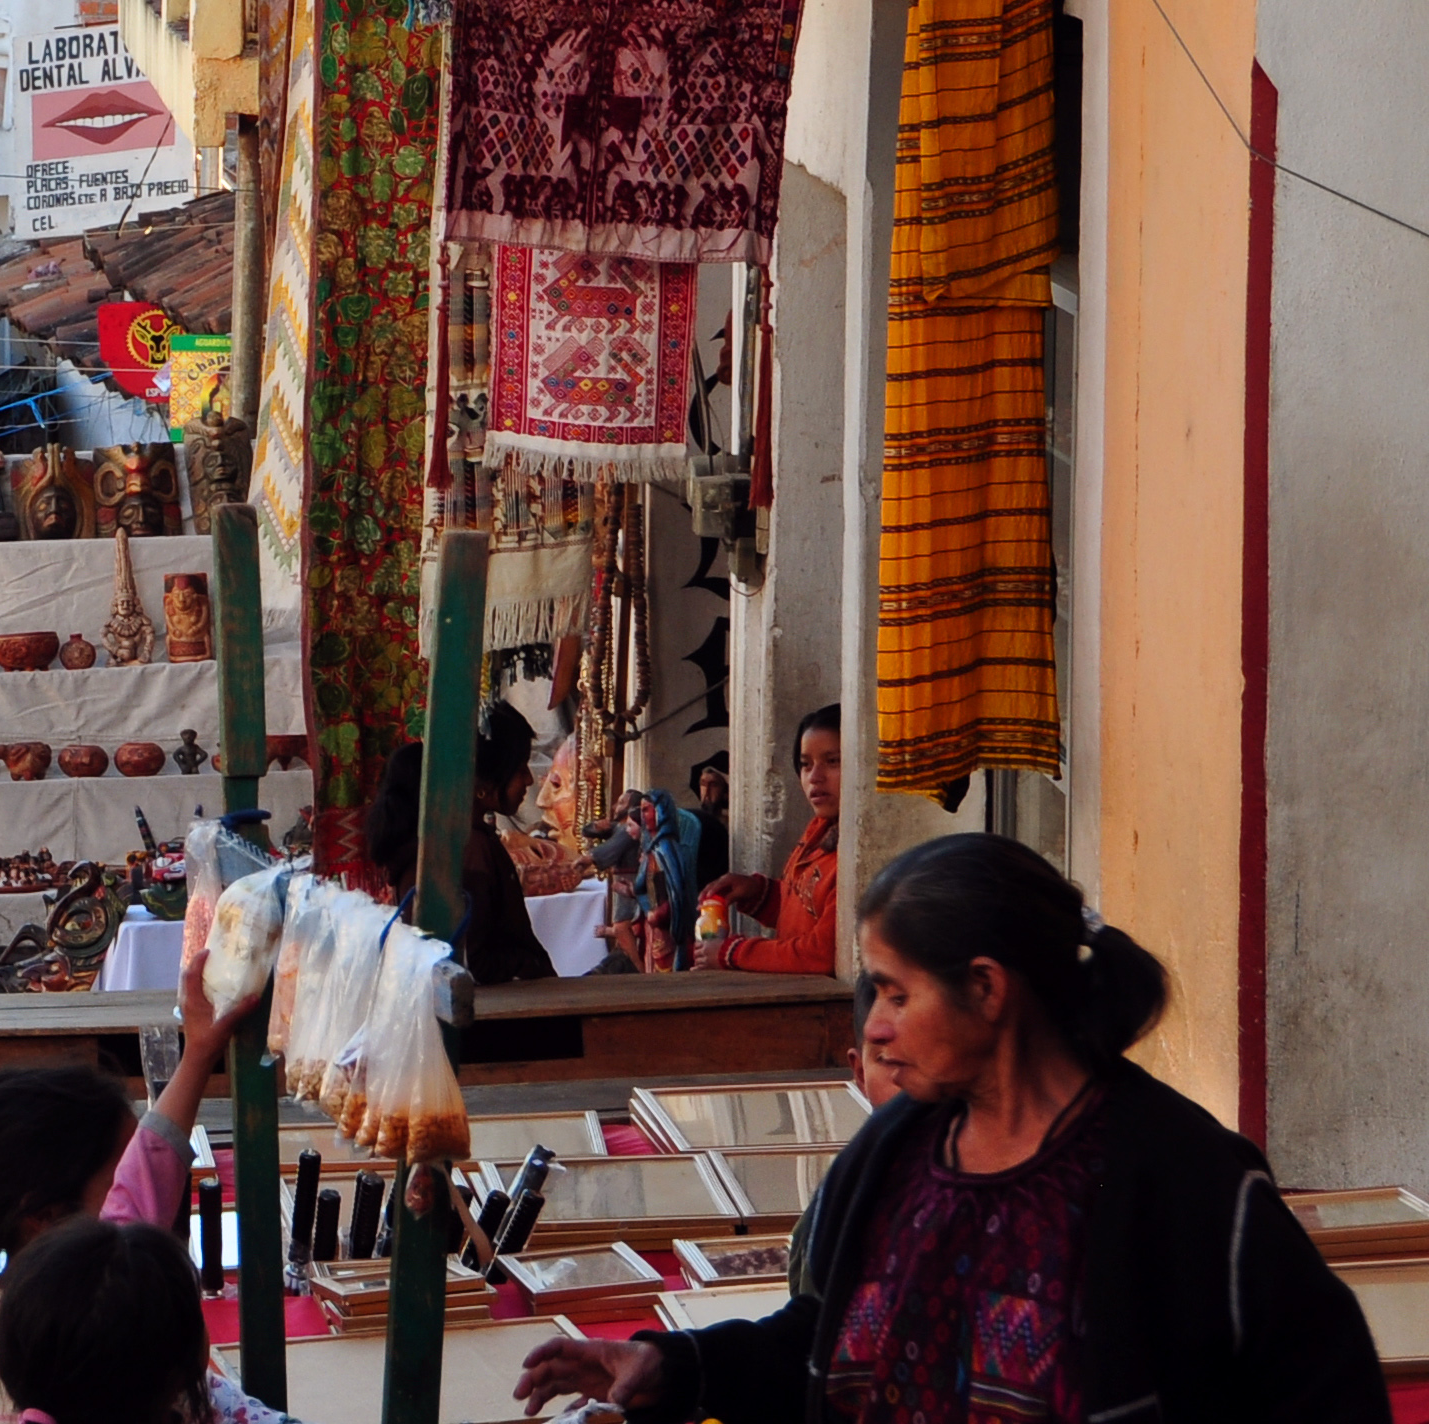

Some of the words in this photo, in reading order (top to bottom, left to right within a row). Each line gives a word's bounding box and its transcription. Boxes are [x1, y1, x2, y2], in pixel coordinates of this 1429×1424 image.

[28, 30, 129, 65] LABORAT
[19, 61, 90, 92] DENTAL
[79, 169, 129, 188] FUENTES
[99, 188, 108, 203] A
[113, 183, 142, 201] BAJO
[147, 178, 189, 197] PRECIO
